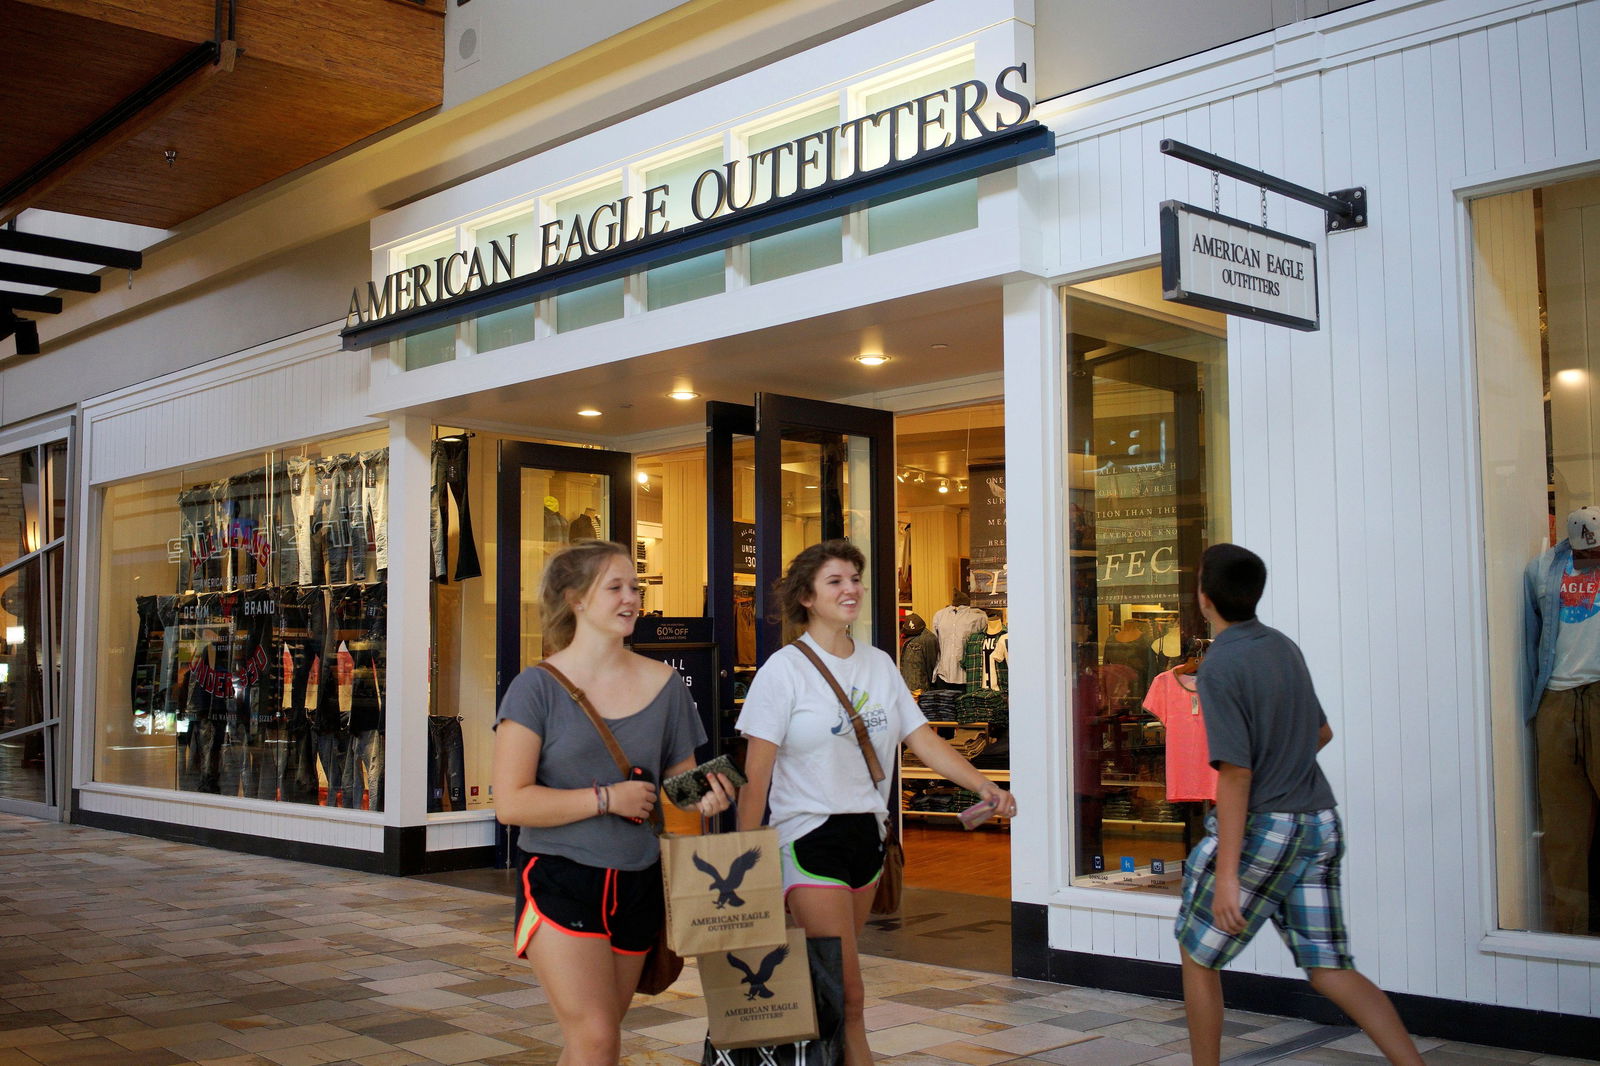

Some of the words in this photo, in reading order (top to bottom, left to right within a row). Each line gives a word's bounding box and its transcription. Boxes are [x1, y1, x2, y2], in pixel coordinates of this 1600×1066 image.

[345, 233, 519, 328] AMERICAN
[540, 184, 670, 271] EAGLE
[691, 62, 1031, 222] OUTFITTERS
[1192, 233, 1261, 269] AMERICAN
[1266, 253, 1305, 281] EAGLE
[1222, 268, 1281, 297] OUTFITTERS
[1125, 508, 1152, 517] THAN
[1097, 545, 1173, 582] FEC
[244, 599, 275, 616] BRAND
[656, 626, 674, 636] 60%
[674, 628, 689, 636] OFF
[189, 654, 235, 699] UNDER
[690, 914, 740, 927] AMERICAN
[741, 910, 771, 921] EAGLE
[707, 921, 755, 932] OUTFITTERS
[724, 1005, 769, 1018] AMERICAN
[771, 1001, 799, 1011] EAGLE
[739, 1011, 784, 1023] OUTFITTERS
